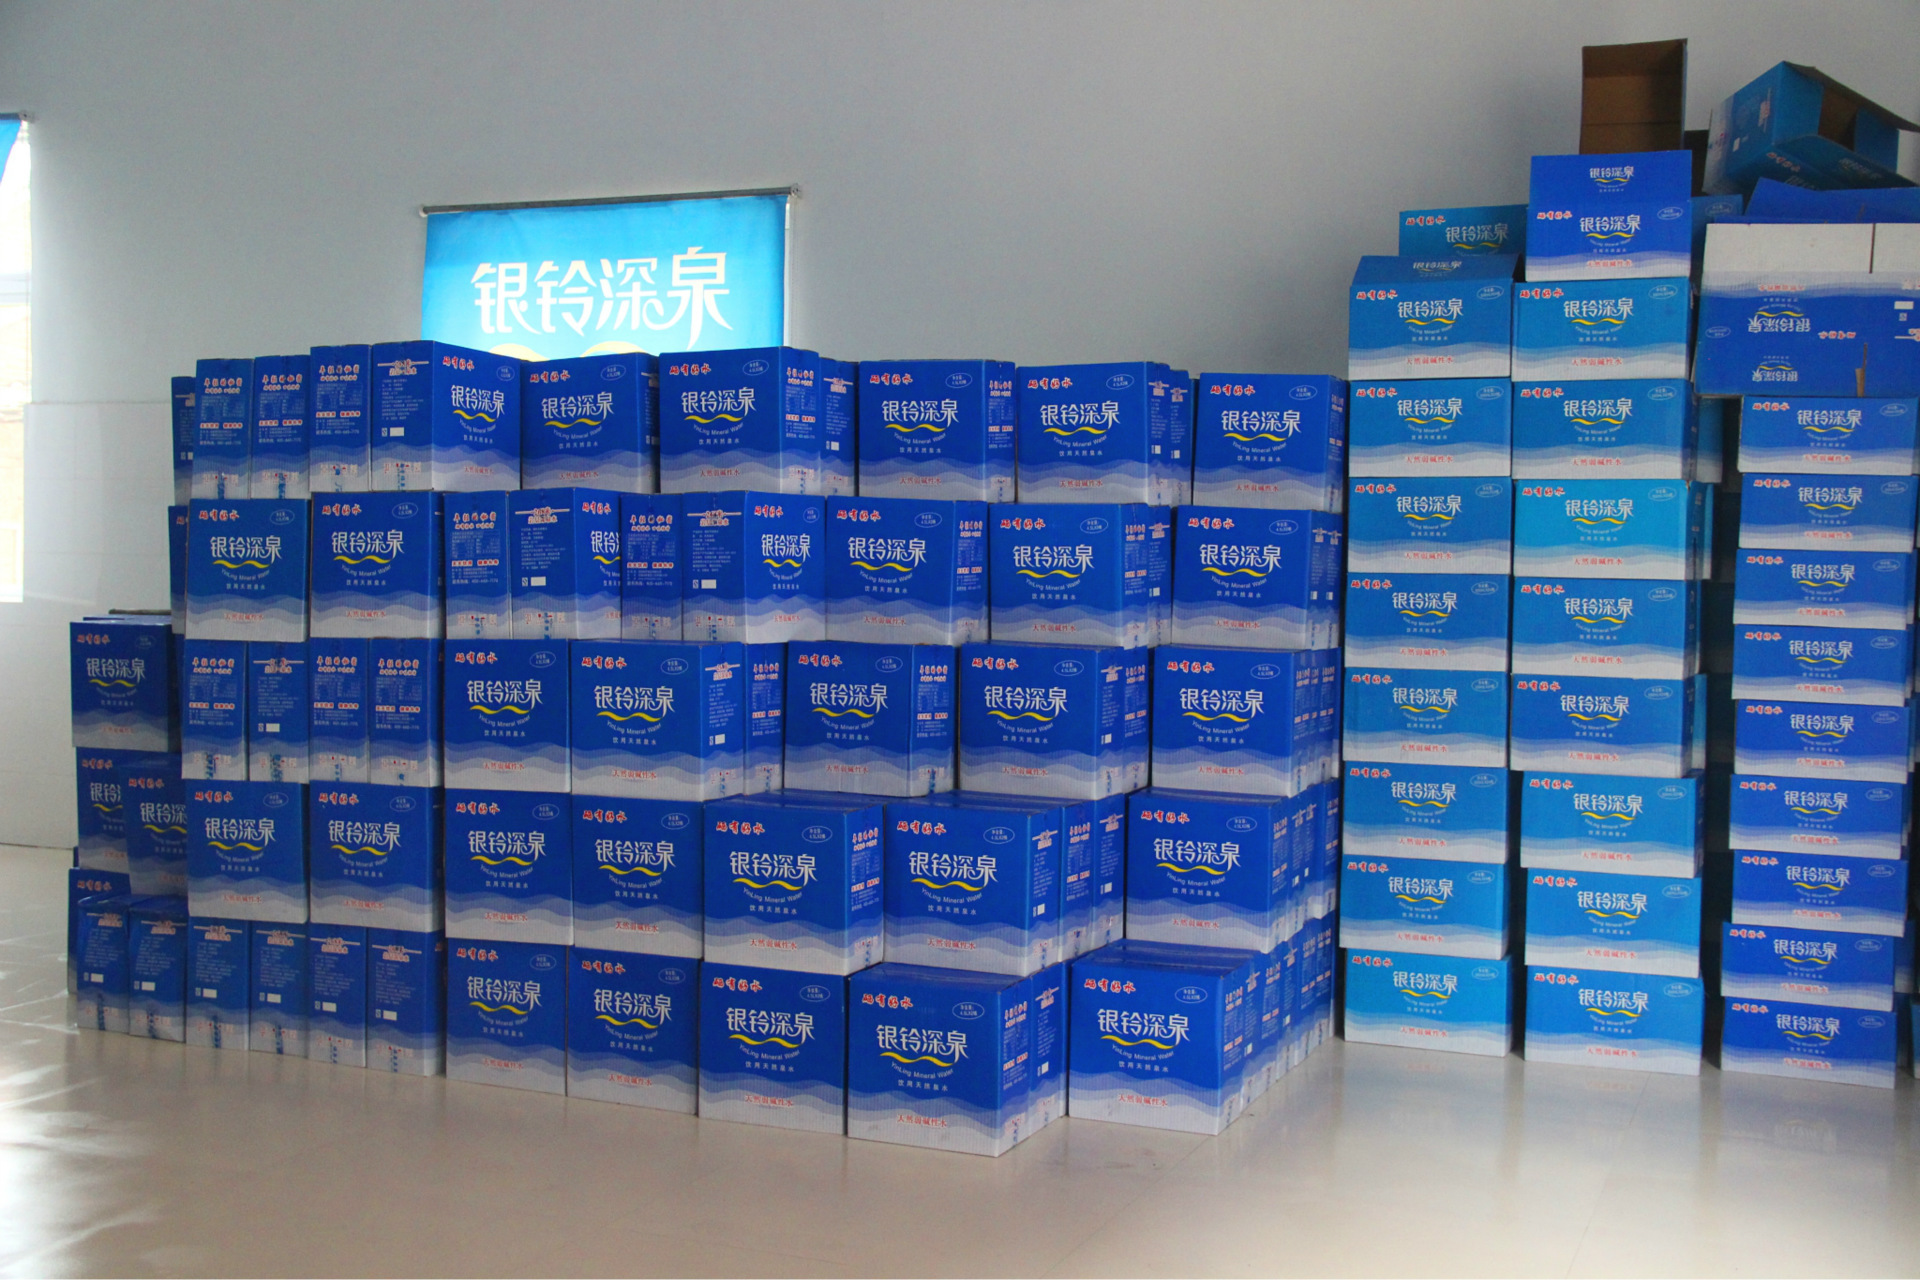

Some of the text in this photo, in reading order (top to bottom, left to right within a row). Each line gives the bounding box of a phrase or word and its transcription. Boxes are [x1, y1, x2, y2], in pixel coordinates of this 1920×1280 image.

[1590, 166, 1635, 180] 银铃深泉
[1445, 222, 1508, 244] 银铃深泉
[1580, 214, 1641, 233] 银铃深泉
[471, 246, 733, 350] 银铃深泉
[1398, 298, 1463, 319] 银铃深泉
[1564, 298, 1634, 320] 银铃深泉
[1748, 315, 1811, 333] 银铃深泉
[451, 385, 504, 416] 银铃深泉
[542, 392, 614, 419] 银铃深泉
[682, 387, 757, 418] 银铃深泉
[1397, 397, 1462, 419] 银铃深泉
[1564, 397, 1633, 419] 银铃深泉
[882, 399, 958, 429] 银铃深泉
[1040, 401, 1120, 430] 银铃深泉
[1222, 410, 1300, 438] 银铃深泉
[1797, 409, 1863, 428] 银铃深泉
[1397, 495, 1461, 515] 银铃深泉
[1565, 497, 1634, 519] 银铃深泉
[1799, 487, 1862, 506] 银铃深泉
[210, 535, 281, 563] 银铃深泉
[332, 529, 404, 560] 银铃深泉
[761, 534, 810, 560] 银铃深泉
[848, 537, 926, 571] 银铃深泉
[1013, 544, 1094, 576] 银铃深泉
[1200, 544, 1281, 575] 银铃深泉
[1791, 564, 1855, 583] 银铃深泉
[1391, 592, 1457, 611] 银铃深泉
[1564, 597, 1633, 619] 银铃深泉
[1790, 640, 1854, 660] 银铃深泉
[86, 658, 145, 682] 银铃深泉
[467, 679, 542, 709] 银铃深泉
[594, 686, 673, 717] 银铃深泉
[810, 683, 887, 713] 银铃深泉
[984, 686, 1067, 717] 银铃深泉
[1180, 688, 1263, 721] 银铃深泉
[1392, 686, 1457, 708] 银铃深泉
[1561, 695, 1630, 717] 银铃深泉
[647, 724, 661, 733] Water
[1790, 714, 1855, 734] 银铃深泉
[1391, 781, 1457, 803] 银铃深泉
[1573, 792, 1643, 815] 银铃深泉
[1784, 791, 1849, 811] 银铃深泉
[205, 818, 275, 846] 银铃深泉
[329, 820, 400, 851] 银铃深泉
[468, 831, 545, 860] 银铃深泉
[595, 839, 675, 870] 银铃深泉
[1154, 838, 1240, 874] 银铃深泉
[730, 852, 816, 886] 银铃深泉
[909, 851, 997, 888] 银铃深泉
[1786, 866, 1851, 887] 银铃深泉
[788, 892, 802, 901] Water
[967, 892, 982, 902] Water
[1389, 876, 1454, 899] 银铃深泉
[1578, 891, 1648, 914] 银铃深泉
[1774, 939, 1838, 960] 银铃深泉
[467, 976, 541, 1007] 银铃深泉
[1393, 971, 1458, 993] 银铃深泉
[594, 989, 671, 1021] 银铃深泉
[1579, 989, 1649, 1013] 银铃深泉
[726, 1008, 814, 1042] 银铃深泉
[1098, 1009, 1189, 1044] 银铃深泉
[1776, 1014, 1841, 1035] 银铃深泉
[876, 1025, 968, 1064] 银铃深泉
[1134, 1053, 1157, 1061] Mineral
[1157, 1052, 1175, 1061] Water
[913, 1071, 936, 1080] Mineral
[937, 1068, 954, 1078] Water
